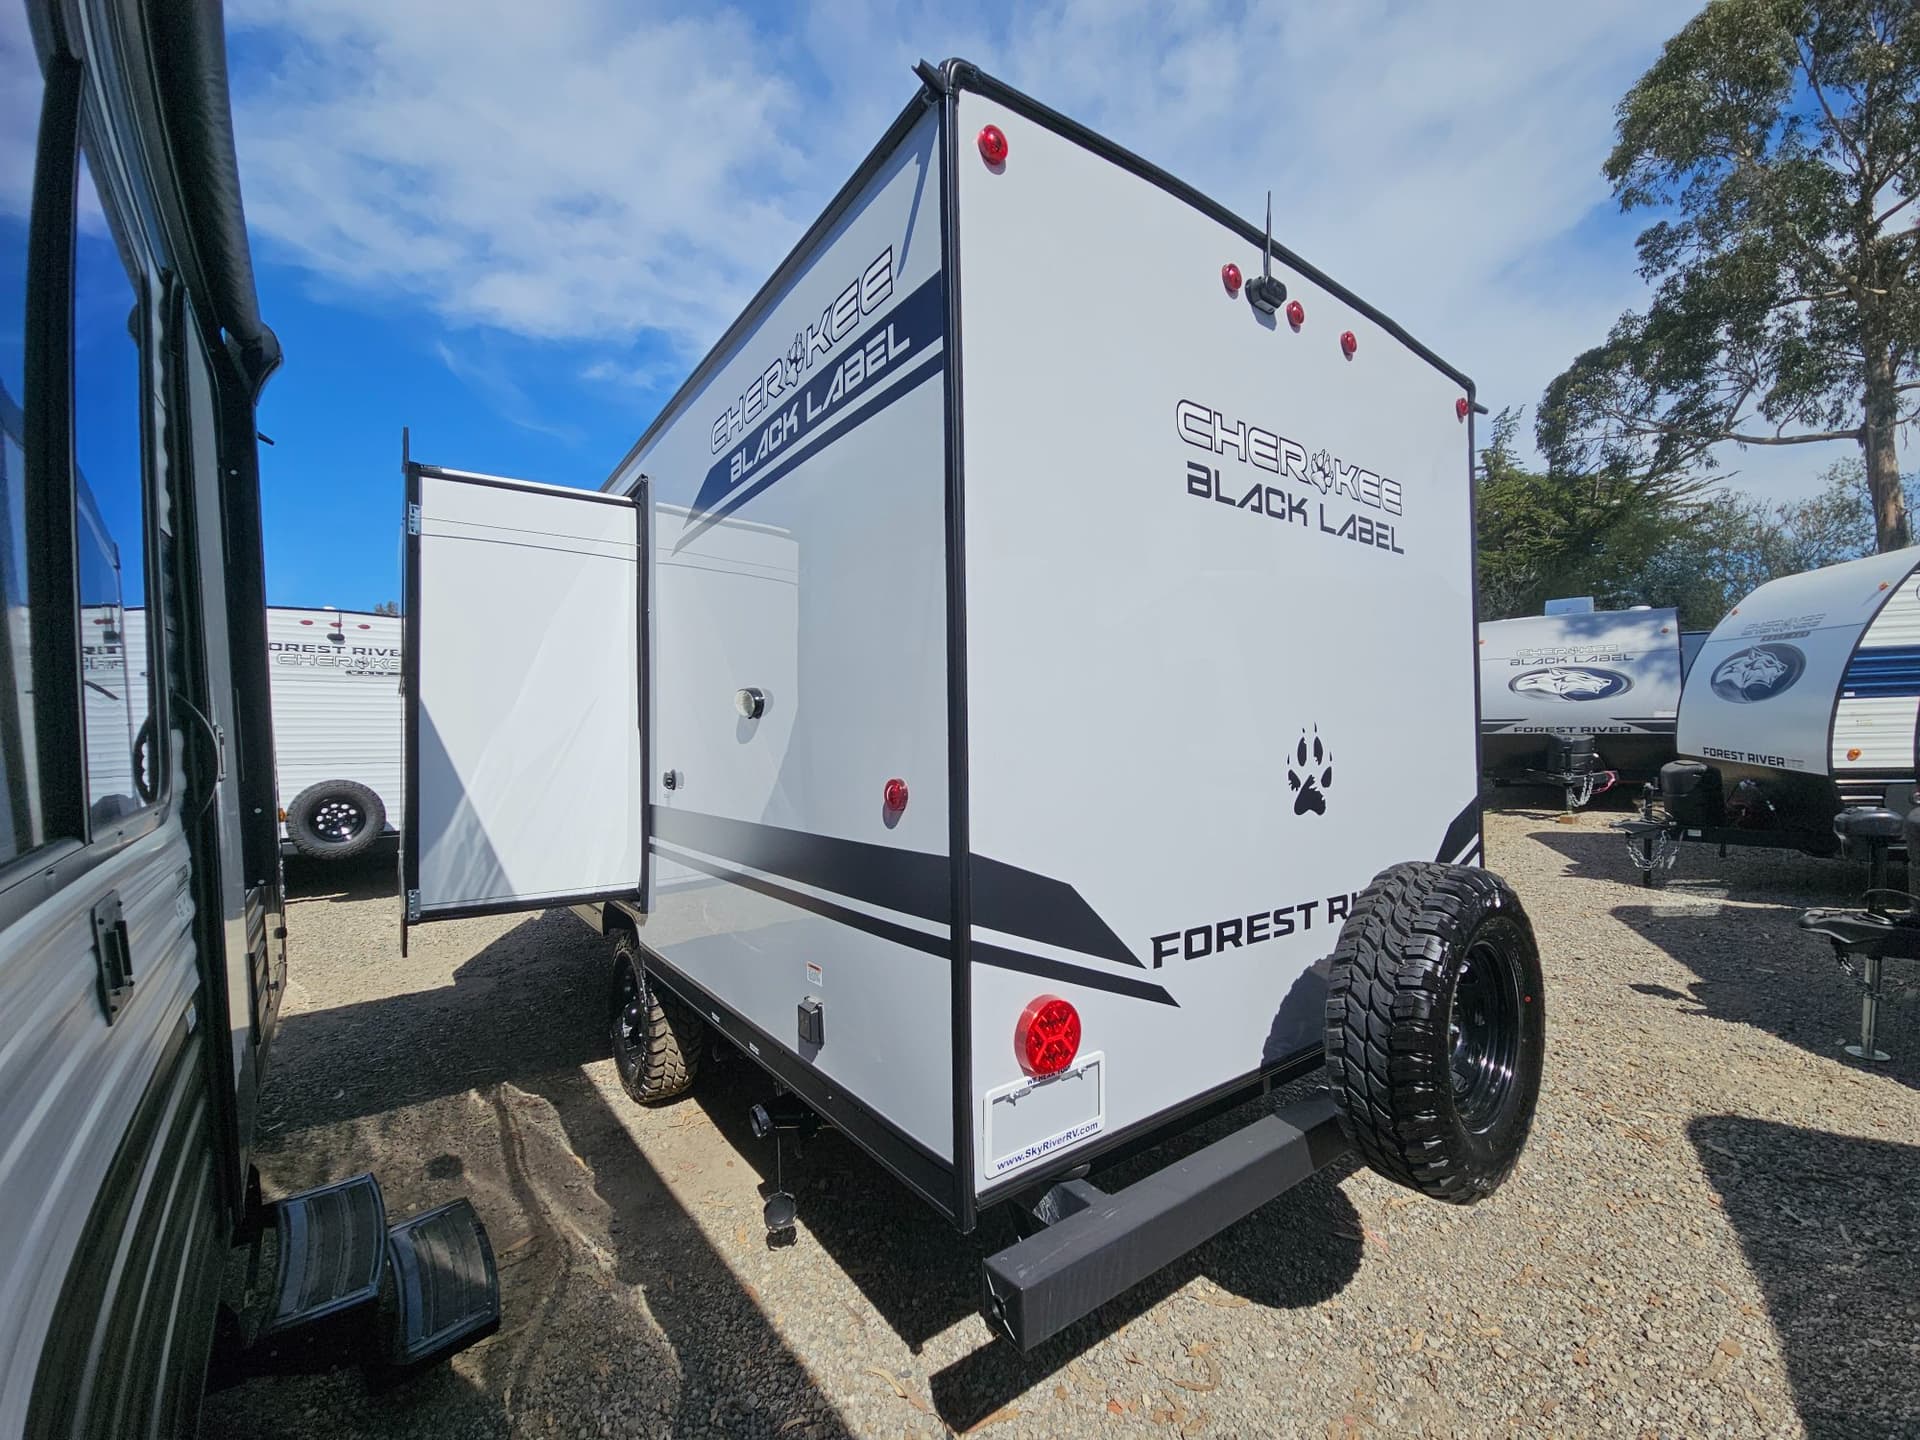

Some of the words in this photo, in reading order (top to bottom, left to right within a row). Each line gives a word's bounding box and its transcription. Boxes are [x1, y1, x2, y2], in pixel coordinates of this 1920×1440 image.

[730, 401, 800, 483] BLACK
[806, 322, 911, 424] LABEL
[1187, 460, 1308, 527] BLACK
[1319, 502, 1405, 555] LABEL
[269, 642, 346, 655] OREST
[352, 647, 401, 657] RIVE
[1510, 656, 1568, 666] BLACK
[1574, 653, 1635, 664] LABEL
[276, 653, 401, 670] CHEROKE
[1513, 726, 1577, 734] FOREST
[1580, 726, 1632, 734] RIVER
[1703, 746, 1745, 761] FOREST
[1747, 752, 1785, 767] RIVER
[1150, 900, 1320, 969] FOREST
[996, 1121, 1099, 1171] www.SkyRiverRV.com
